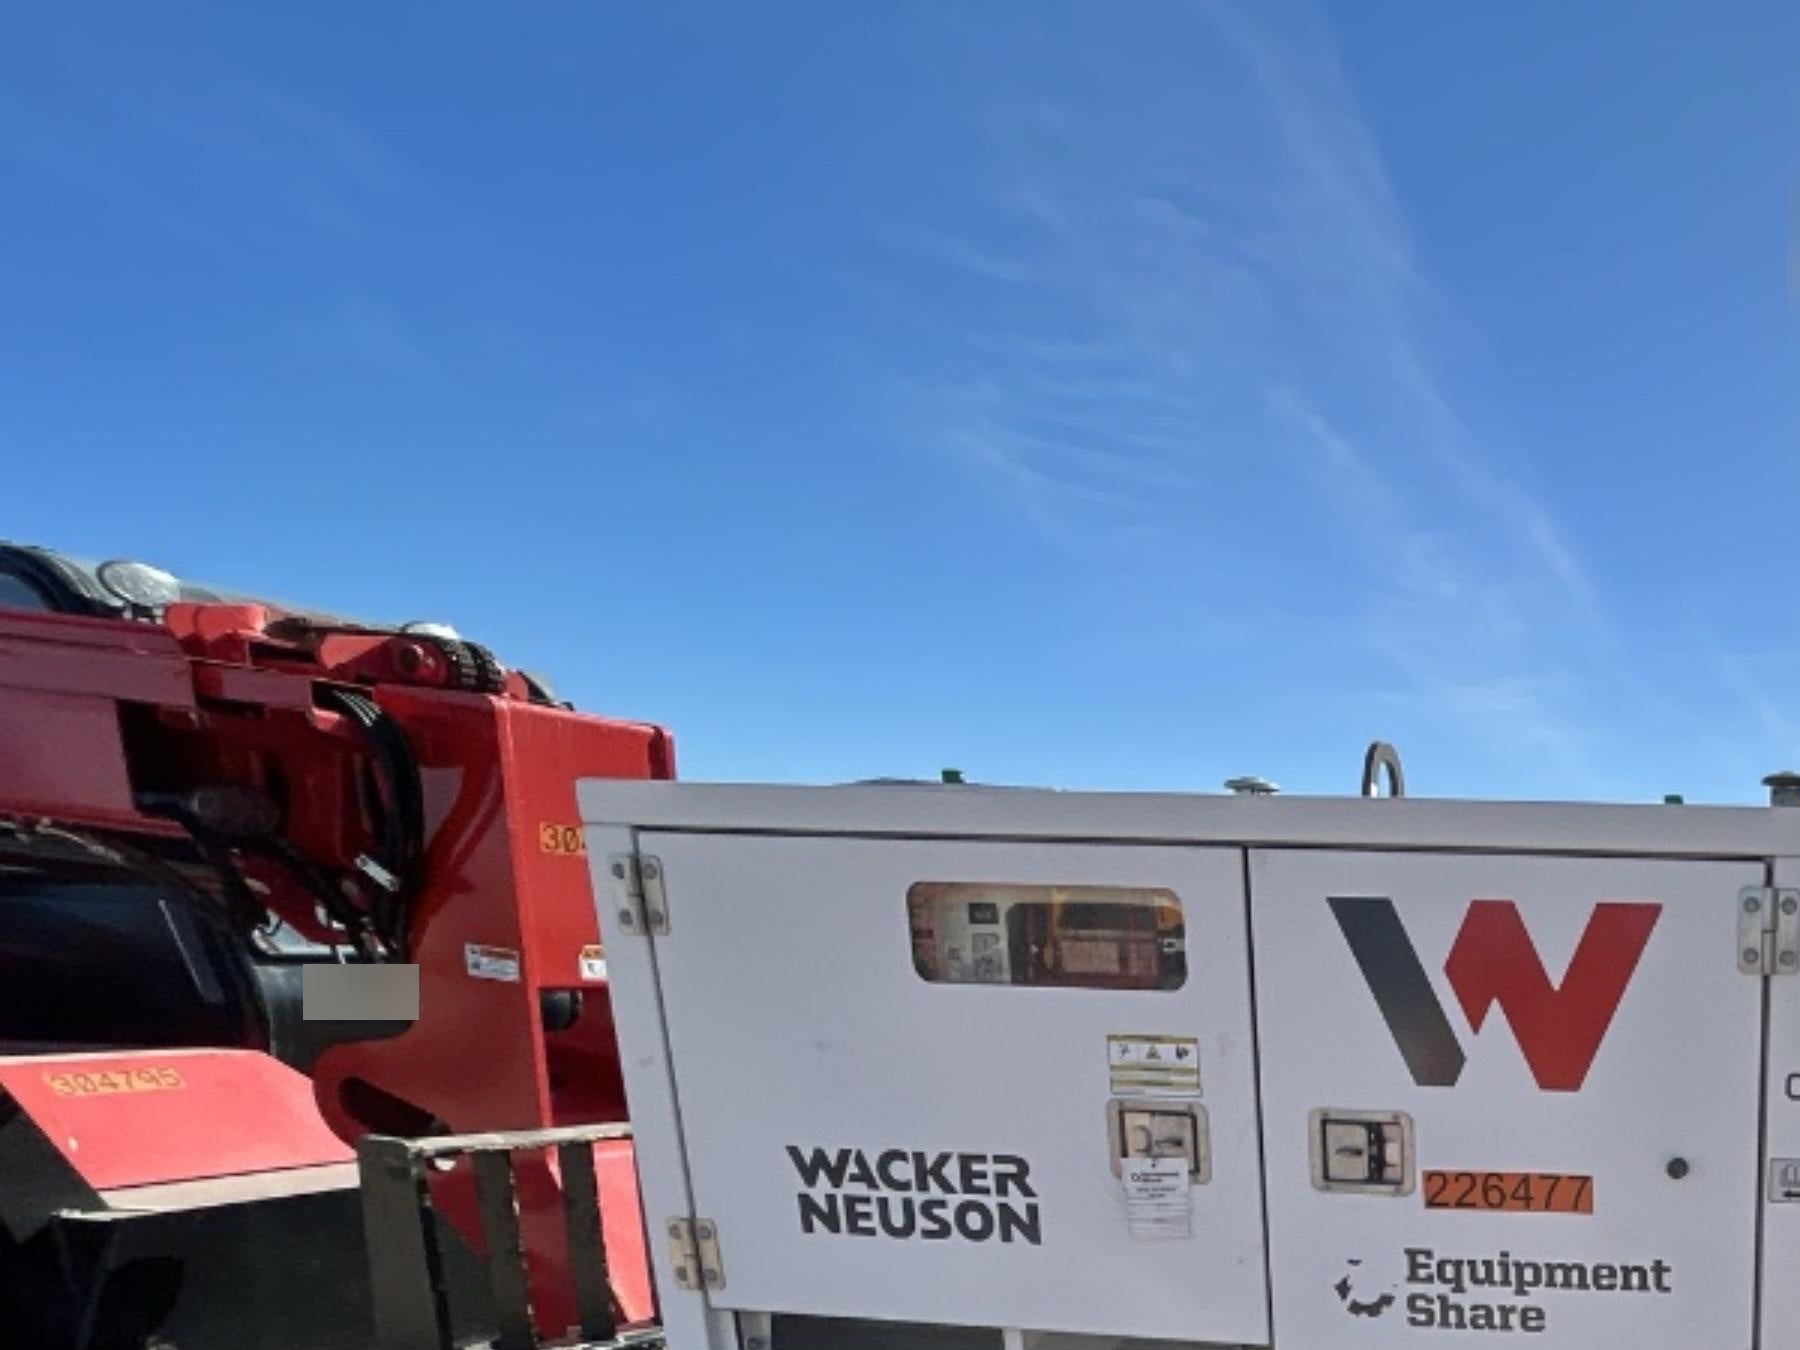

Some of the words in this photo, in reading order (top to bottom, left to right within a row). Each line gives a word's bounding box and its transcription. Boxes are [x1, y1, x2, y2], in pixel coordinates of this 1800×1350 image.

[542, 824, 586, 853] 30
[785, 1145, 1039, 1198] WACKER
[1424, 1172, 1592, 1210] 226477
[797, 1193, 1042, 1246] NEUSON
[1403, 1248, 1672, 1297] Equipment
[1405, 1293, 1547, 1333] Share
